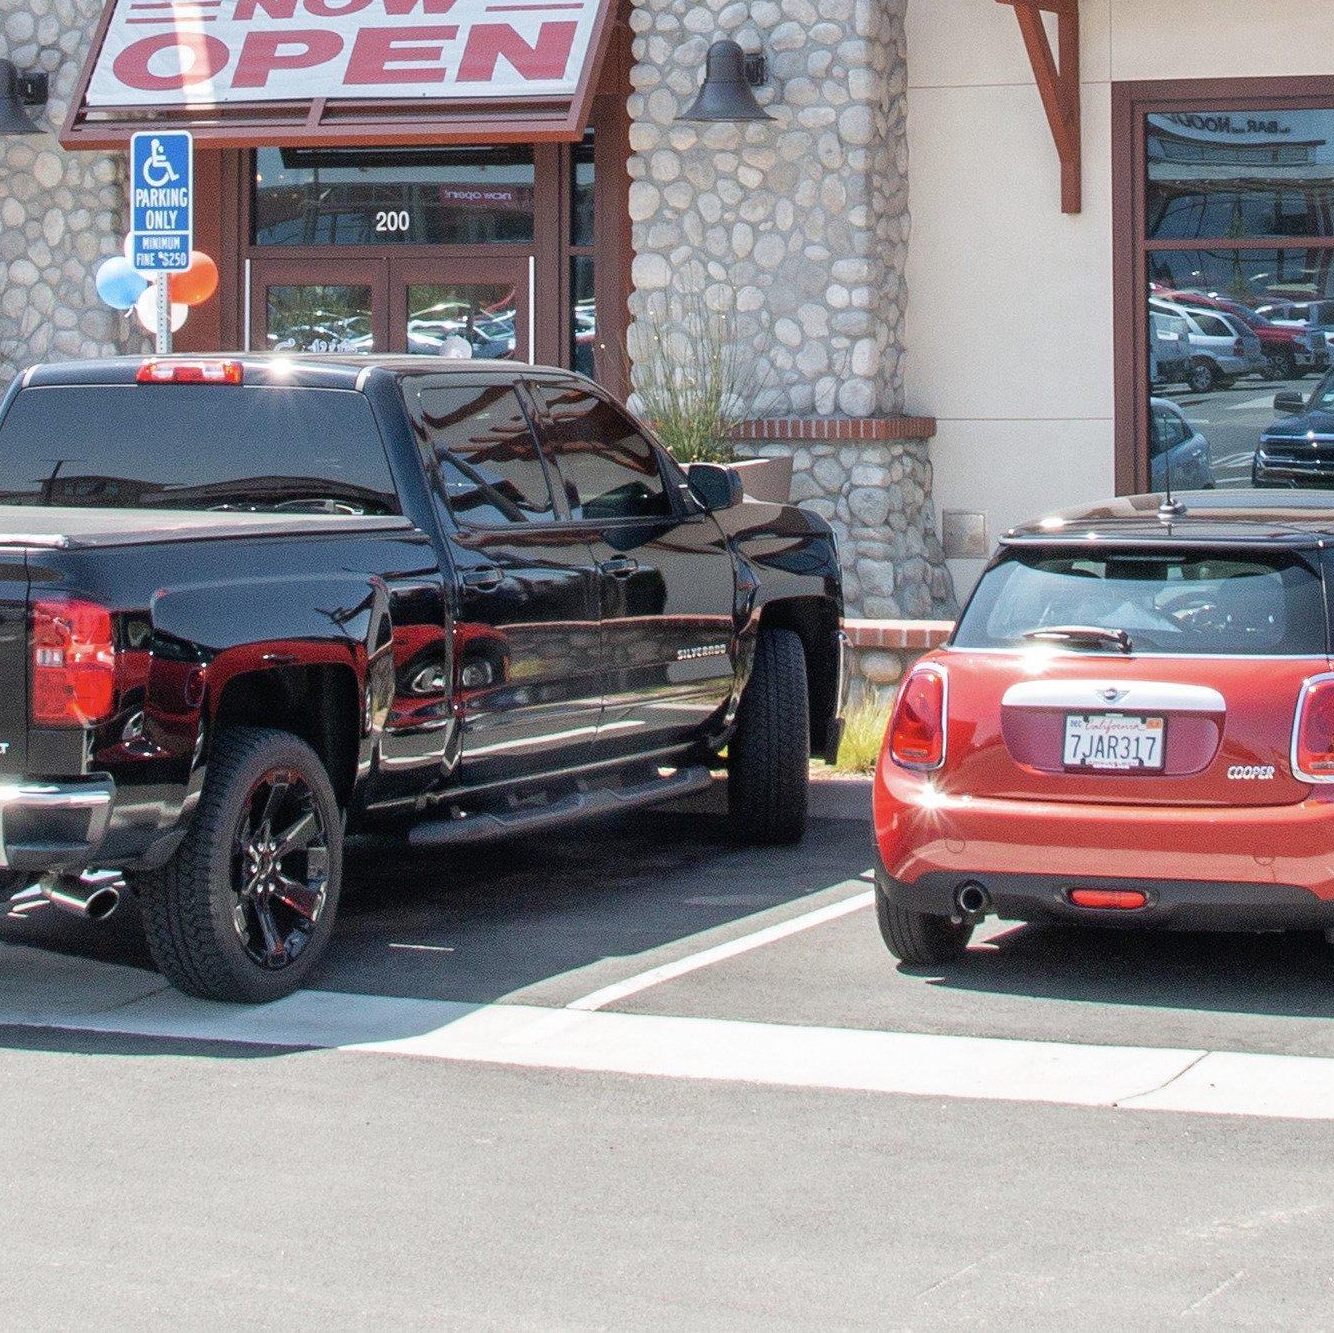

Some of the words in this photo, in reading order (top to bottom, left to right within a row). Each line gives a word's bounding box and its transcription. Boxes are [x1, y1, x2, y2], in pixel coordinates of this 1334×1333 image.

[113, 20, 579, 91] OPEN
[136, 188, 188, 207] PARKING
[145, 209, 178, 229] ONLY
[376, 211, 409, 231] 200
[142, 236, 181, 250] MINIMUM
[136, 253, 155, 266] FINE
[677, 644, 727, 660] SILVERADO
[1084, 719, 1140, 734] California
[1071, 734, 1157, 760] 7JAR317
[1227, 765, 1275, 779] COOPER
